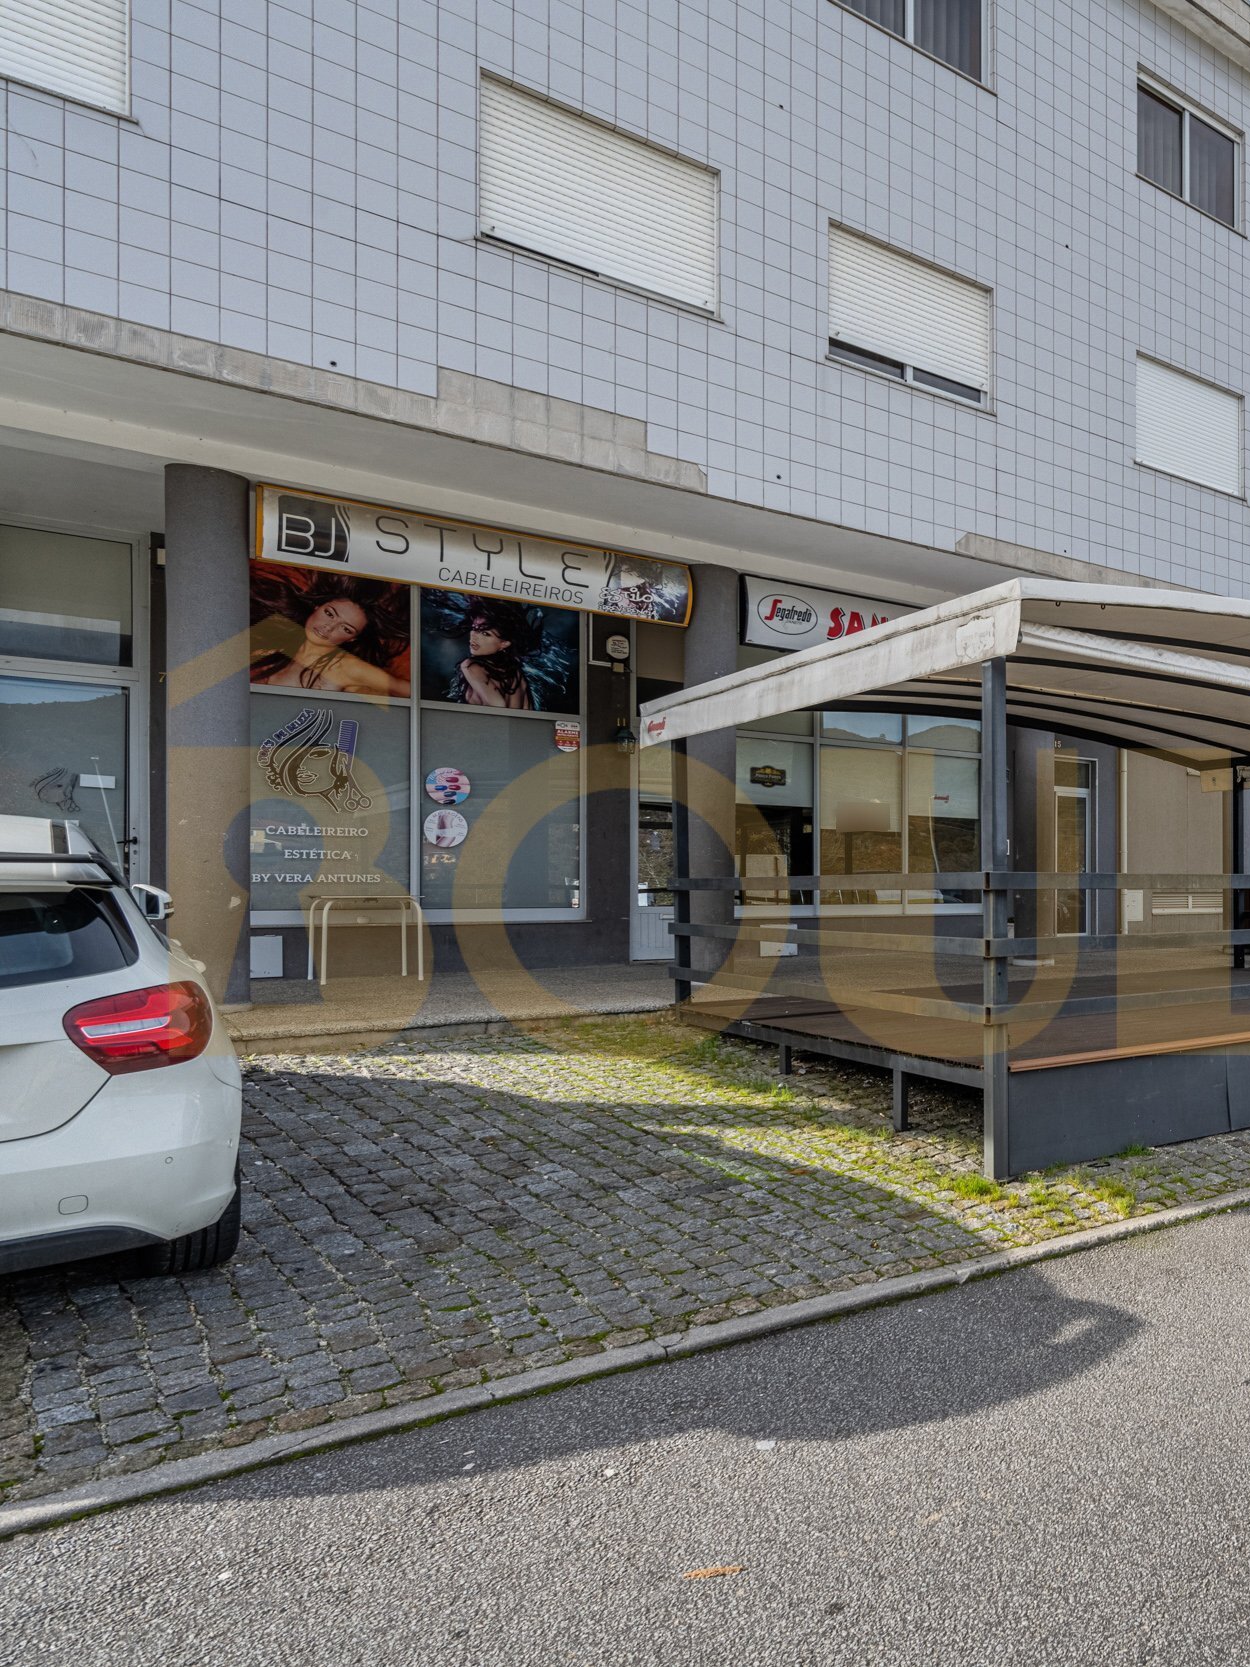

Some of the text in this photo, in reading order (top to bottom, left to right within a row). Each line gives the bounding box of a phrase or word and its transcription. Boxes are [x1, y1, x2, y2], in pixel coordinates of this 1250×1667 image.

[281, 512, 589, 588] BJ STYLE
[438, 567, 584, 604] CABELEIREIROS
[764, 599, 812, 623] Segafredo
[158, 671, 167, 683] 7
[617, 717, 626, 727] 11
[1054, 740, 1062, 749] 15
[266, 825, 368, 837] CABELEIREIRO
[284, 848, 351, 860] ESTÉTICA
[252, 873, 381, 883] BY VERA ANTUNES
